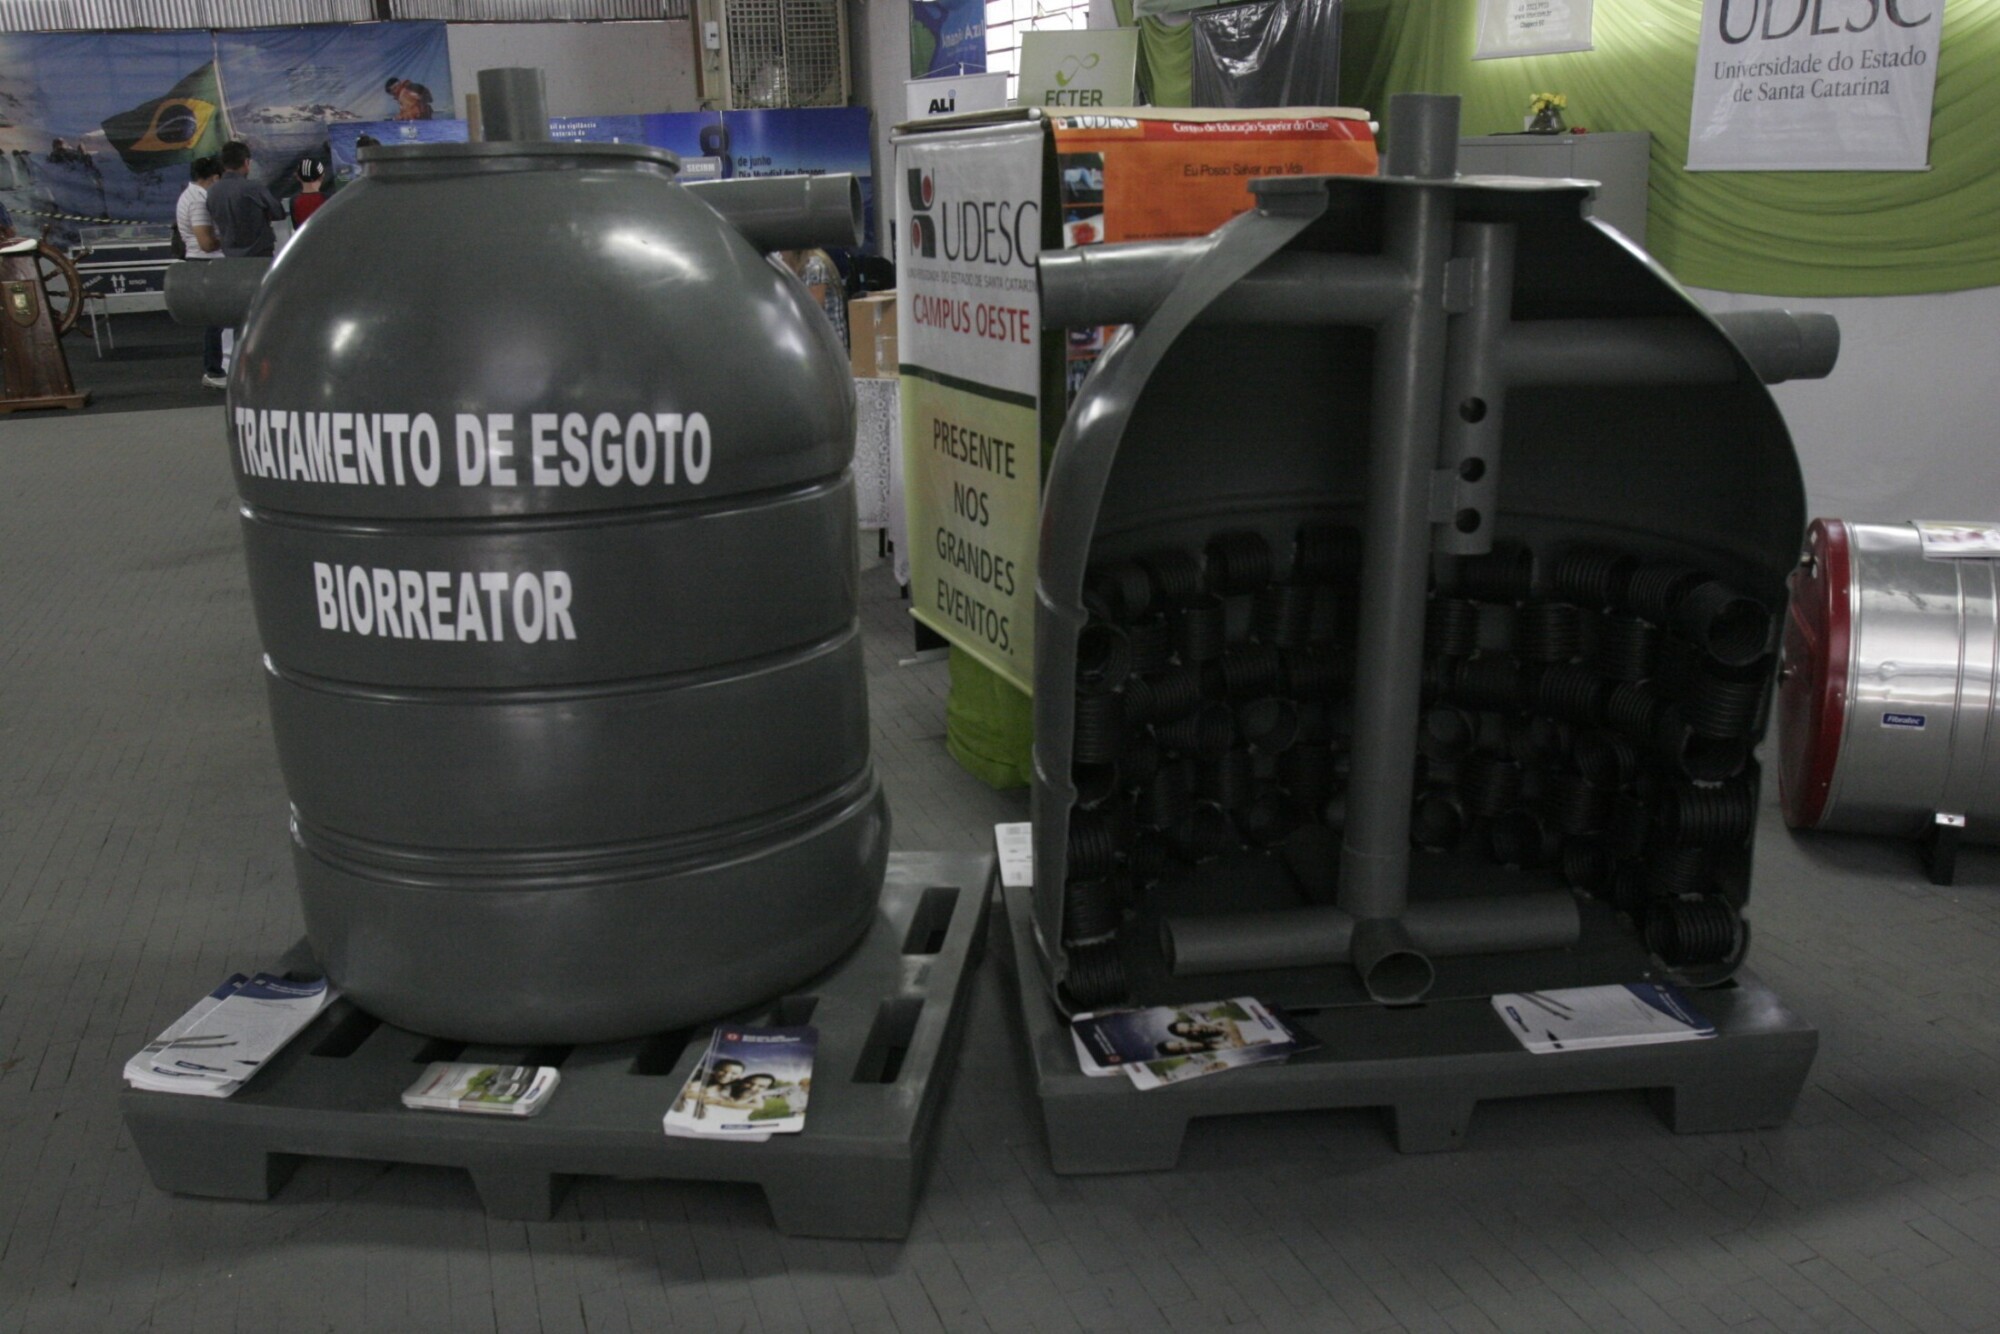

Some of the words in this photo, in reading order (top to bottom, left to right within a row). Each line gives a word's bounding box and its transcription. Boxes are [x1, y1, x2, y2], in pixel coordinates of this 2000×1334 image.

[1714, 54, 1822, 80] Universidade
[1827, 51, 1853, 72] do
[1860, 45, 1926, 70] Estado
[1733, 84, 1752, 102] de
[1757, 82, 1804, 101] Santa
[1811, 77, 1889, 98] Catarina
[1204, 122, 1217, 132] de
[1257, 121, 1292, 134] Superior
[1293, 120, 1304, 131] do
[1305, 120, 1329, 131] Oeste
[942, 200, 1038, 267] UDESC
[913, 294, 970, 334] CAMPUS
[976, 303, 1030, 344] OESTE
[235, 406, 441, 487] TRATAMENTO
[455, 413, 516, 487] DE
[531, 412, 712, 487] ESGOTO
[933, 418, 1016, 479] PRESENTE
[954, 481, 989, 527] NOS
[937, 527, 1015, 597] GRANDES
[313, 561, 577, 644] BIORREATOR
[937, 578, 1014, 655] EVENTOS.
